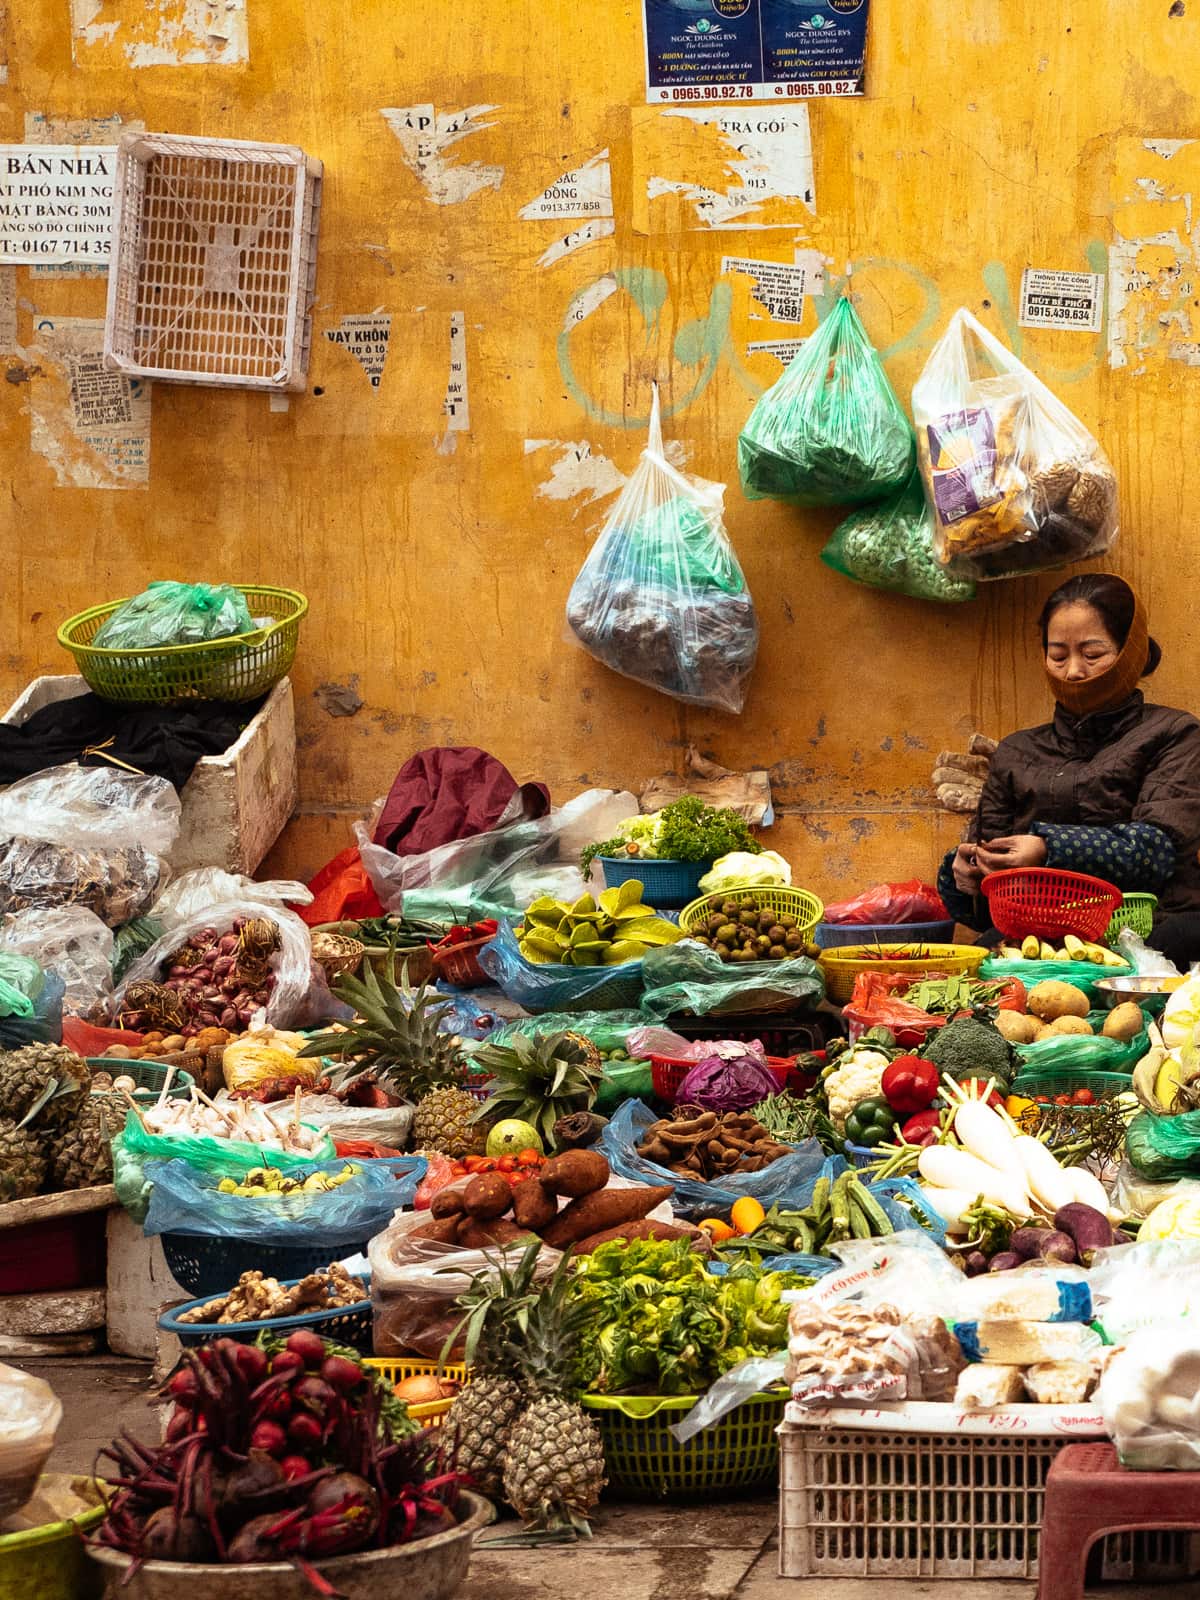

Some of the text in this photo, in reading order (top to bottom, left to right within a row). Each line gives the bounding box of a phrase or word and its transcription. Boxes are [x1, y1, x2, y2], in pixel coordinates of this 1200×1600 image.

[672, 85, 753, 100] 0965.90.92.78
[786, 82, 860, 96] 0965.90.92.7
[7, 153, 109, 175] BÁN NHÀ
[55, 186, 86, 197] KIM
[544, 184, 578, 199] ĐỒNG
[82, 205, 115, 217] 30M
[540, 201, 600, 213] 0913.377.858
[22, 239, 58, 253] 0167
[63, 240, 90, 253] 714
[93, 240, 112, 254] 35
[777, 304, 798, 318] 458
[1028, 305, 1090, 320] 0915.439.634
[327, 328, 390, 343] VAY KHÔN
